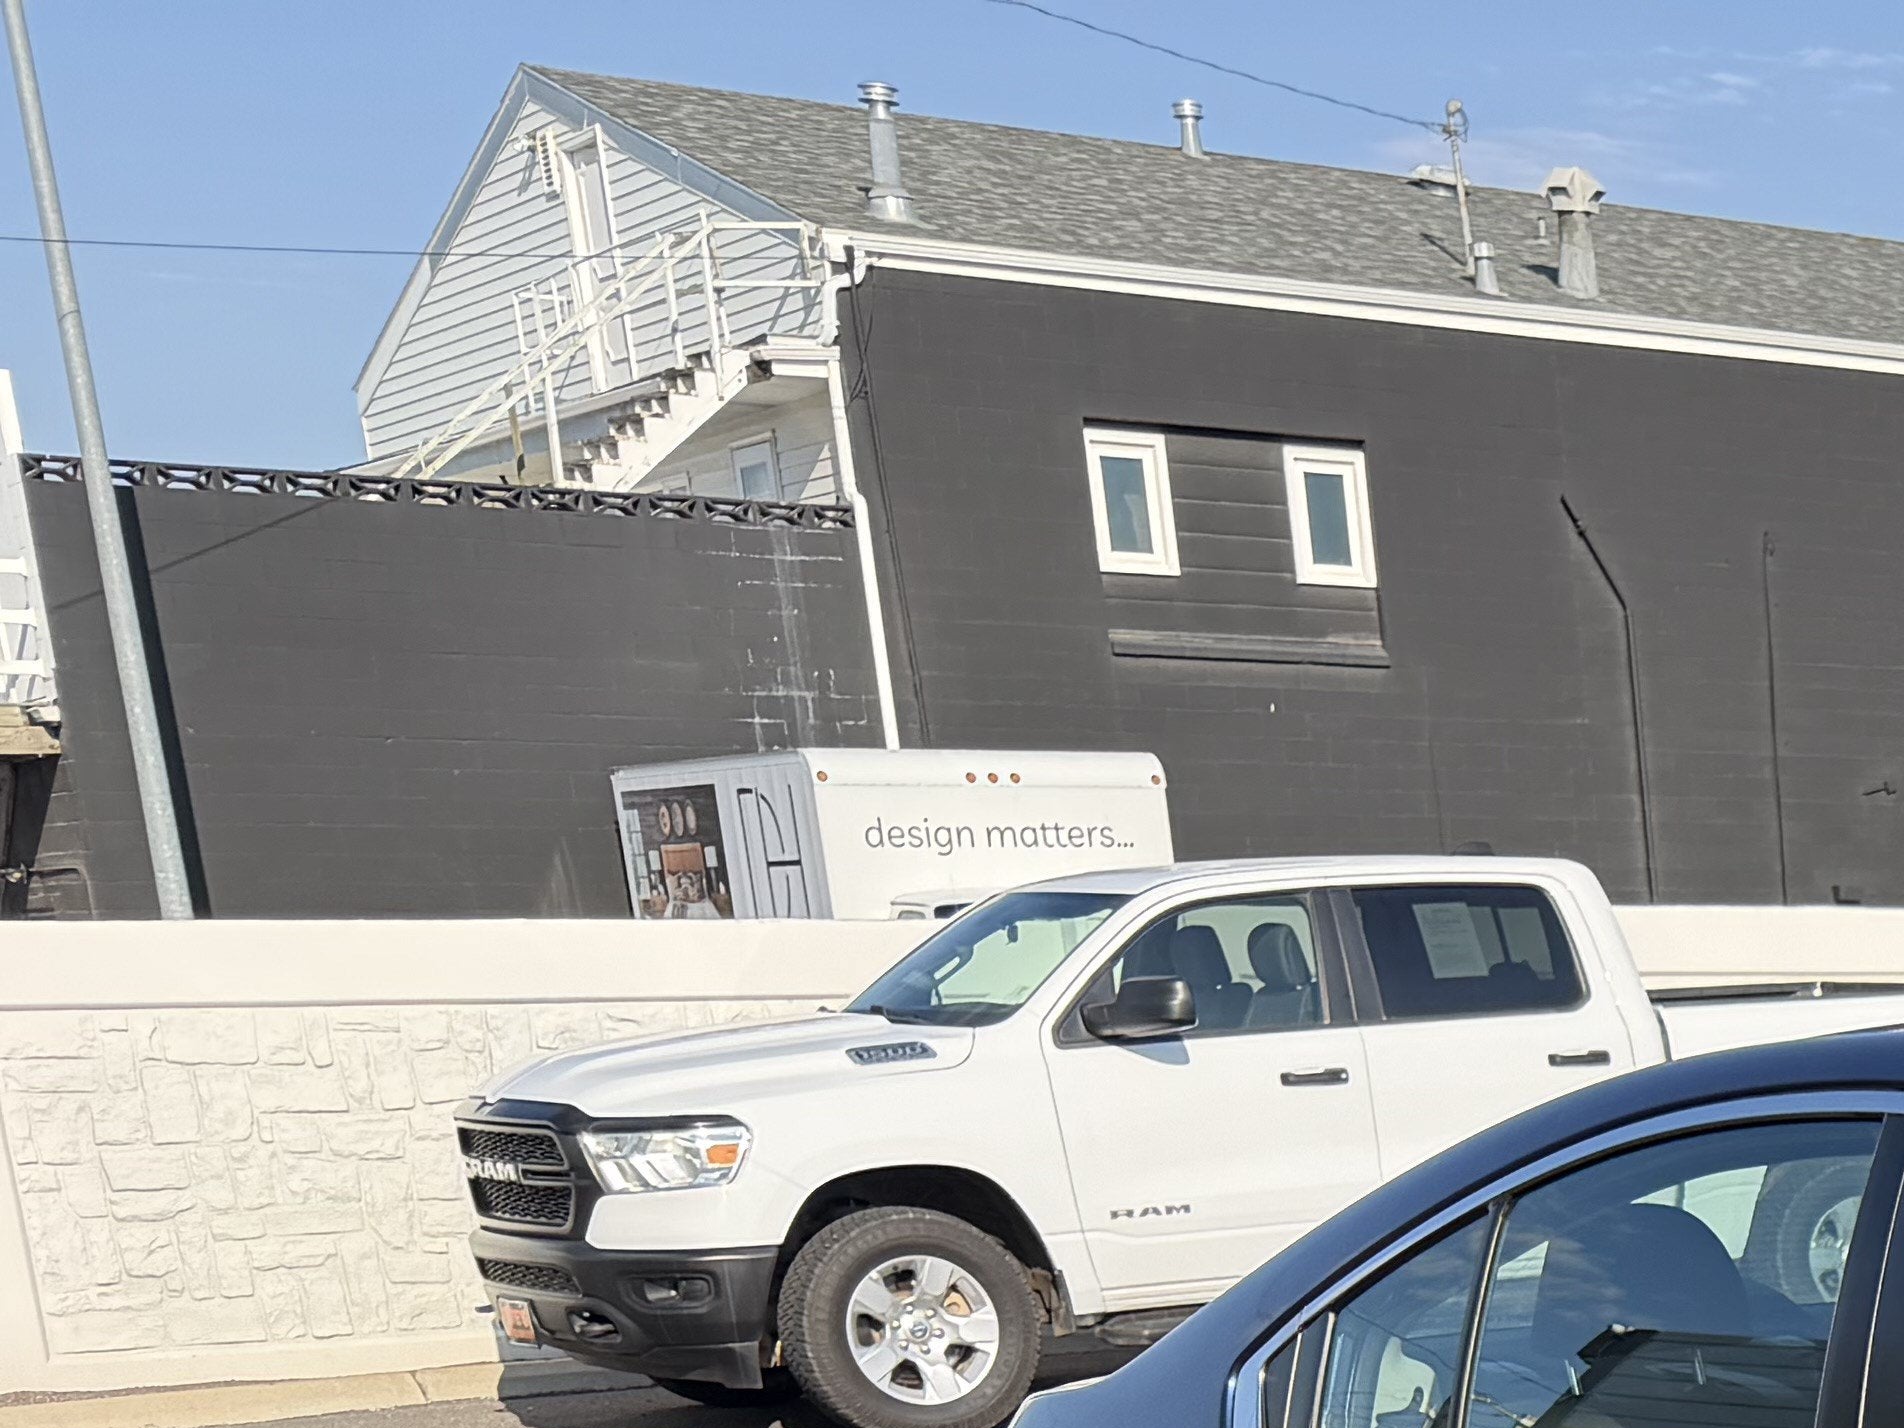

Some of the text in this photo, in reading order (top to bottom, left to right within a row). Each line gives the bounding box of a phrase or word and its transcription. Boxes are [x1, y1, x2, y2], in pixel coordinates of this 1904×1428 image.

[864, 817, 1136, 855] design matters...
[1109, 1203, 1191, 1219] RAM
